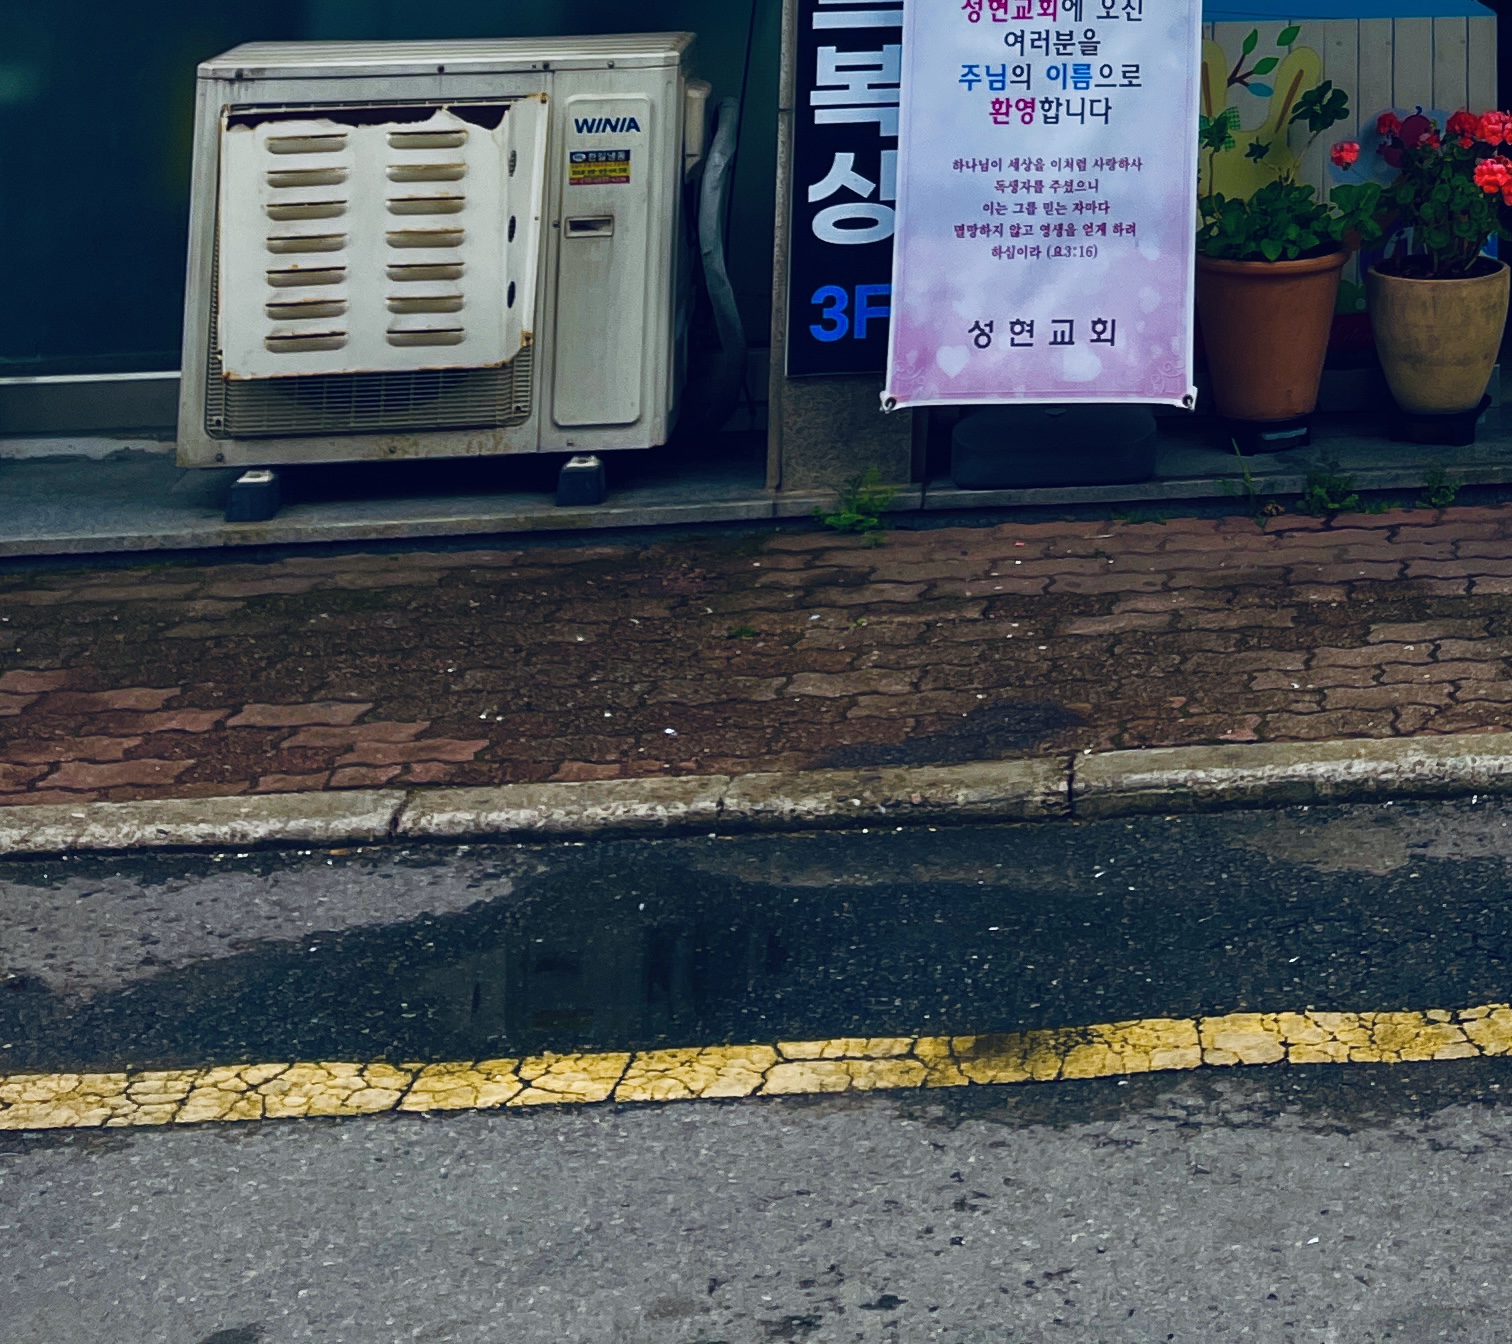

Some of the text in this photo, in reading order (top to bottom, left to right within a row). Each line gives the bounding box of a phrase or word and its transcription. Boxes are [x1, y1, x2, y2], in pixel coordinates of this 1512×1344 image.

[1003, 28, 1102, 58] 여러분을
[958, 62, 1143, 92] 주님의 이름으로
[988, 96, 1113, 126] 환영합니다
[574, 117, 641, 134] WINIA
[952, 156, 1144, 173] 하나님이 세상을 이처럼 사랑하사
[994, 179, 1045, 194] 독생자를
[982, 200, 1009, 216] 이는
[1071, 200, 1111, 215] 자마다
[1039, 222, 1078, 238] 영생을
[808, 284, 893, 343] 3F
[967, 317, 1118, 349] 성현교회
